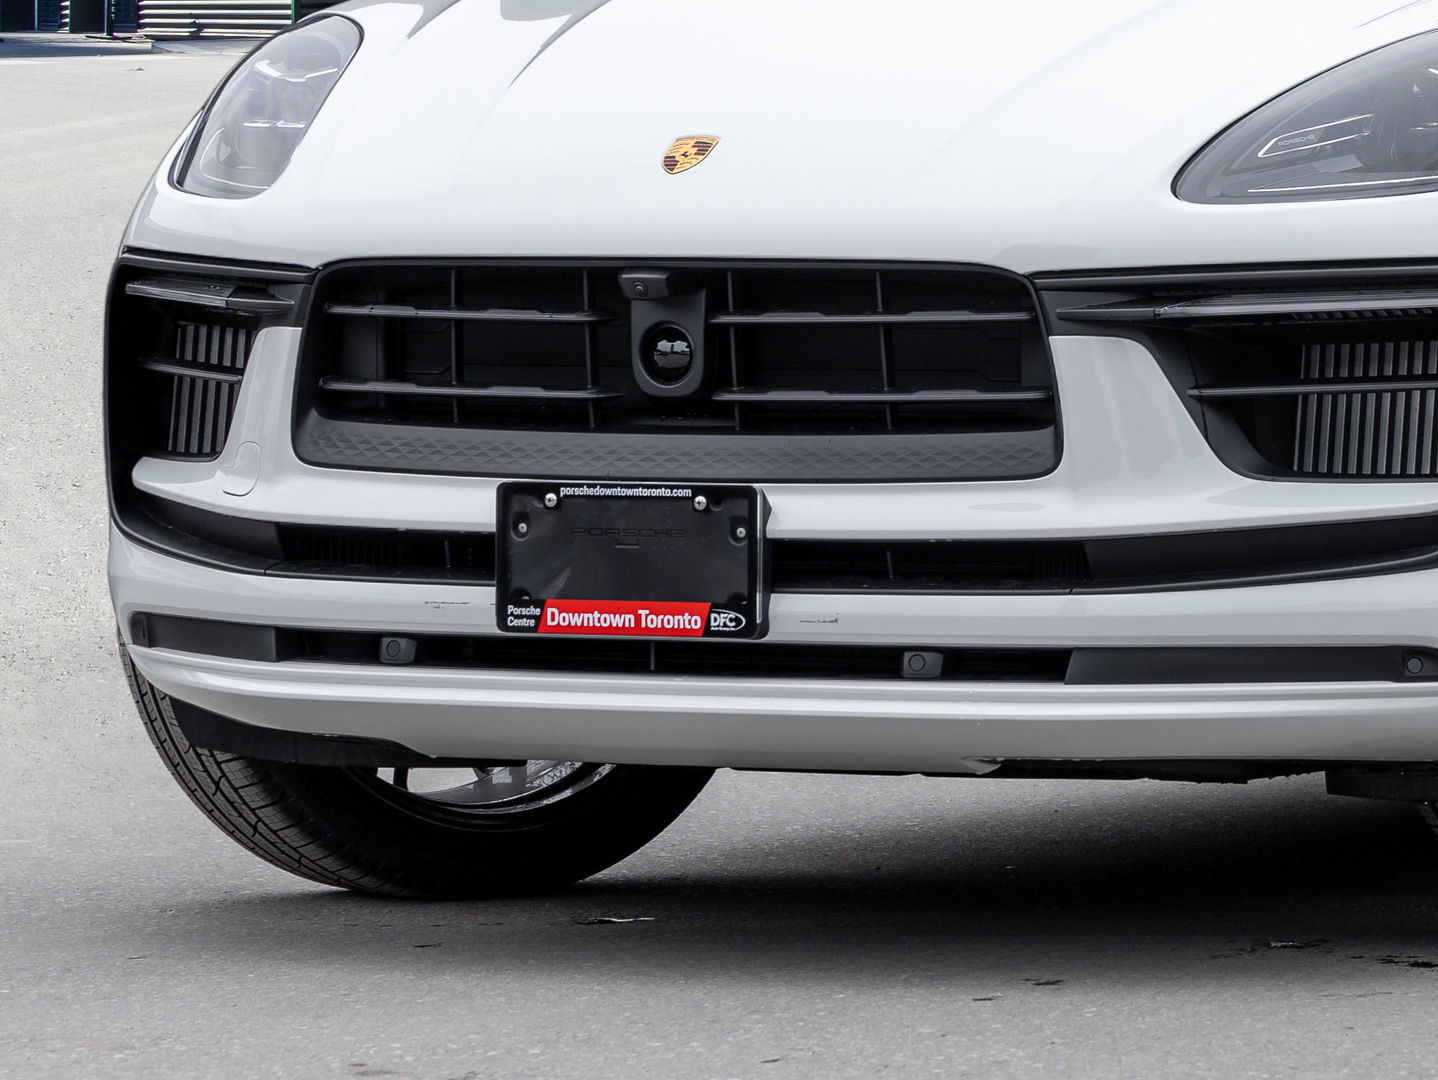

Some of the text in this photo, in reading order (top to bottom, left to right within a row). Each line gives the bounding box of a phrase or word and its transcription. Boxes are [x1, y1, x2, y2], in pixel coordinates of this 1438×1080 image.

[560, 485, 692, 497] porschedowntowntoronto.com
[570, 527, 686, 538] PORSCHE
[508, 605, 736, 630] Porsche Downtown Toronto DFC
[508, 617, 535, 626] Centre
